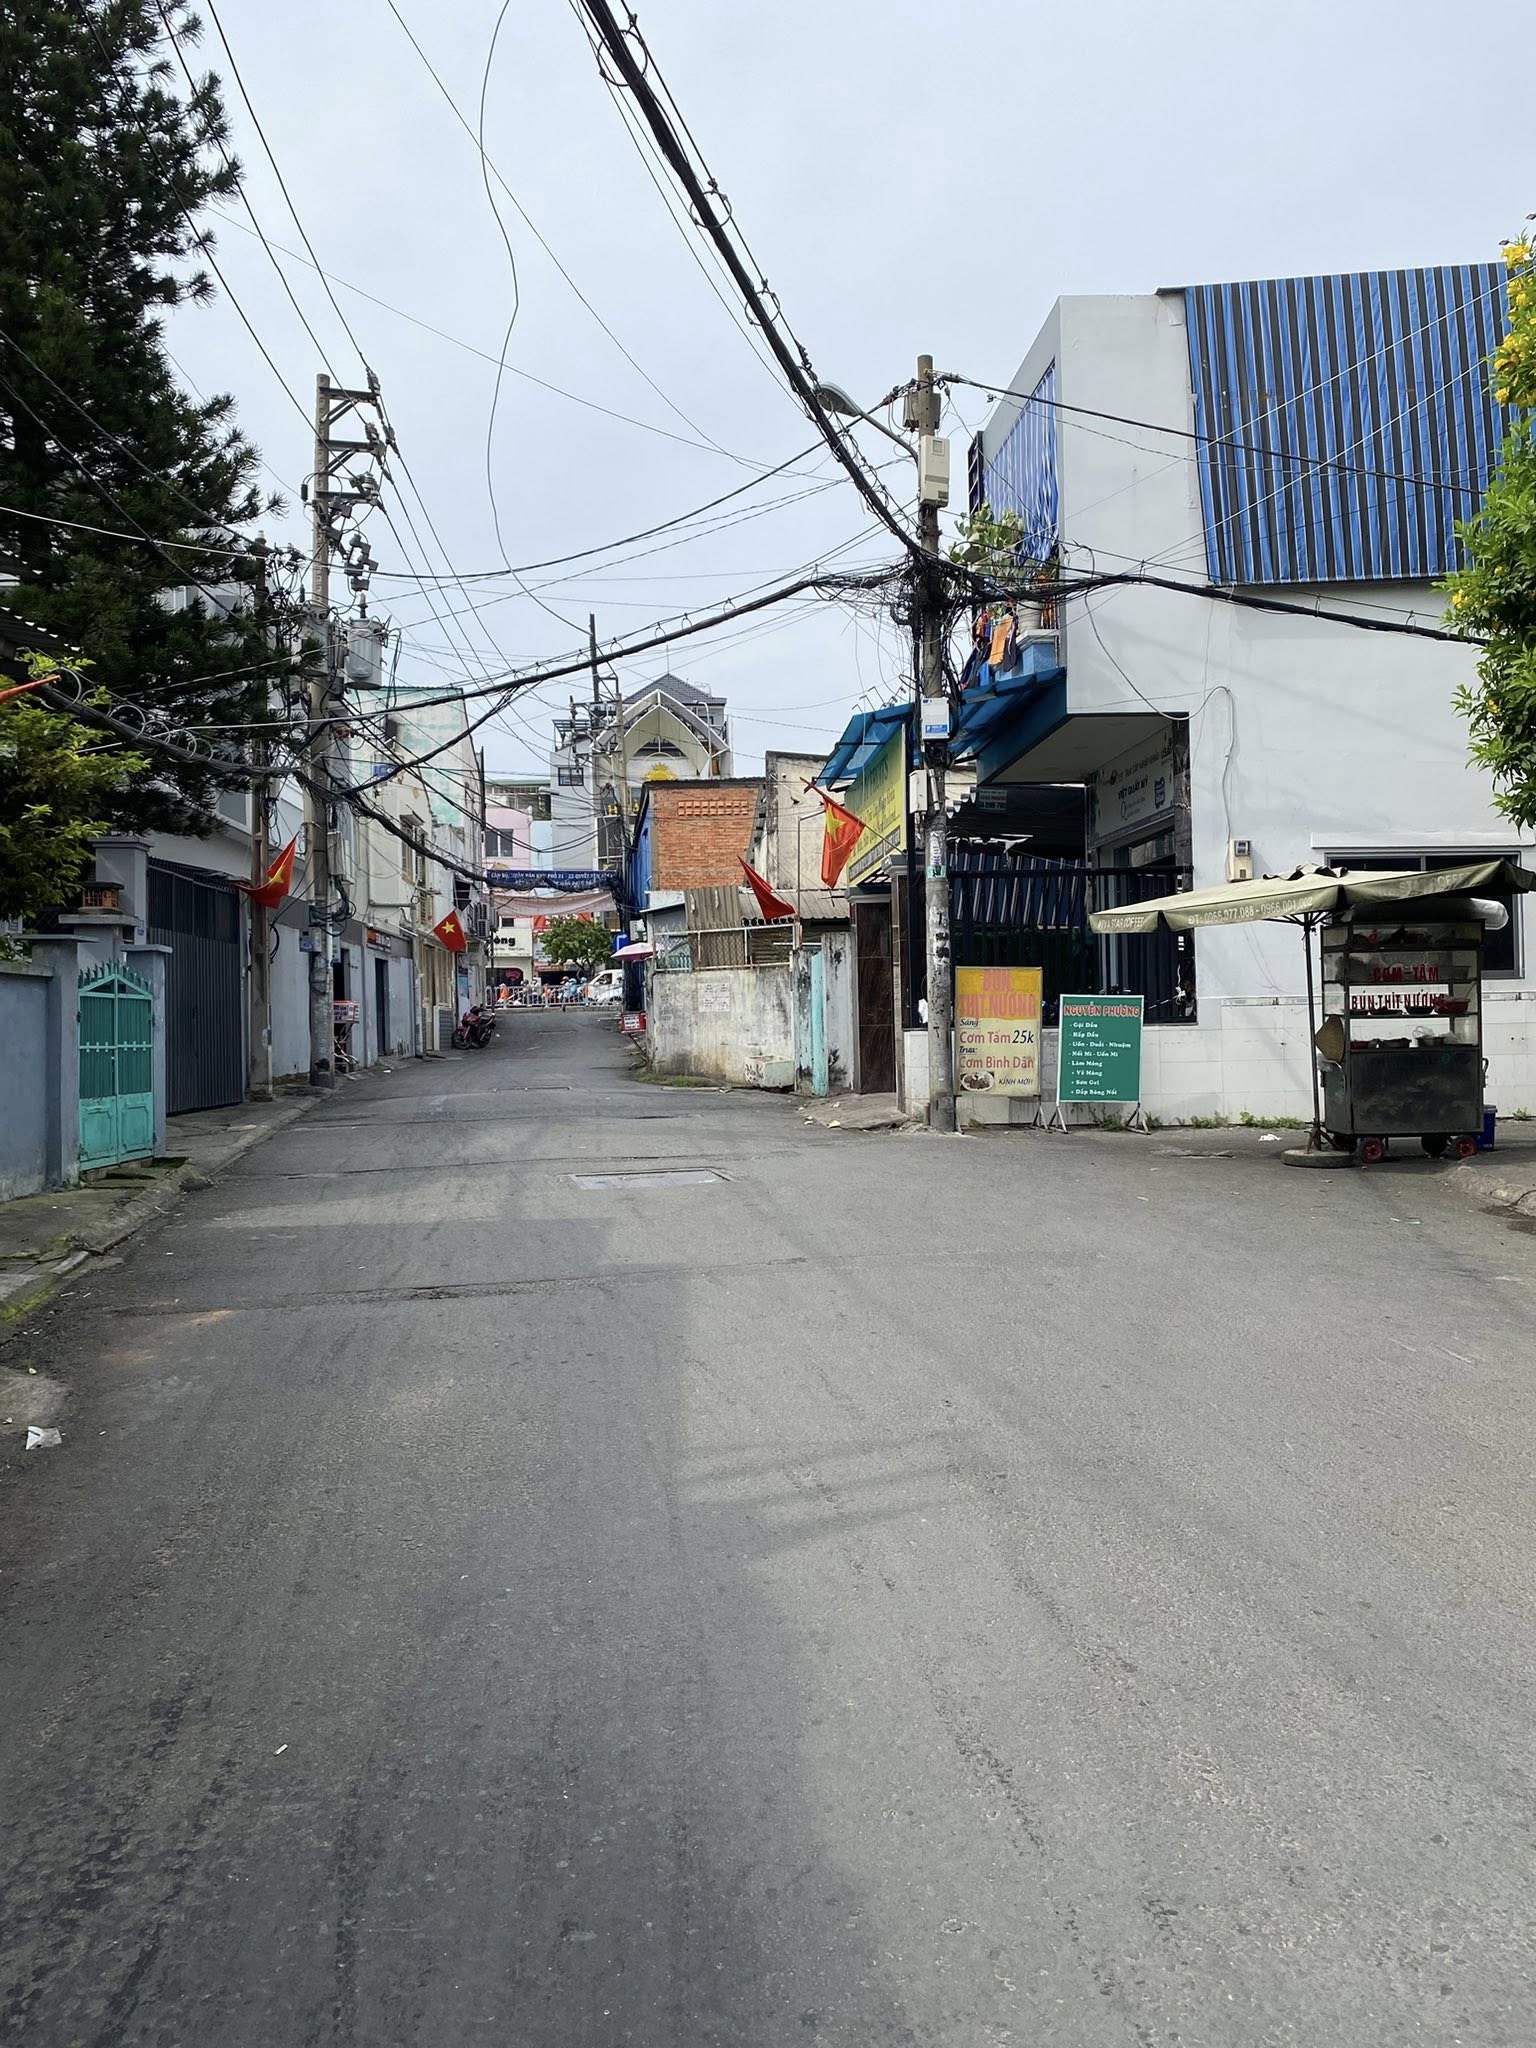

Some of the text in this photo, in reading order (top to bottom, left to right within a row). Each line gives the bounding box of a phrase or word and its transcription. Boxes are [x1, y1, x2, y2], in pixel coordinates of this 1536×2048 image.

[1063, 1001, 1102, 1016] NGUYỄN
[959, 1028, 1034, 1044] Cơm Tấm 25k
[959, 1056, 984, 1069] Cơm
